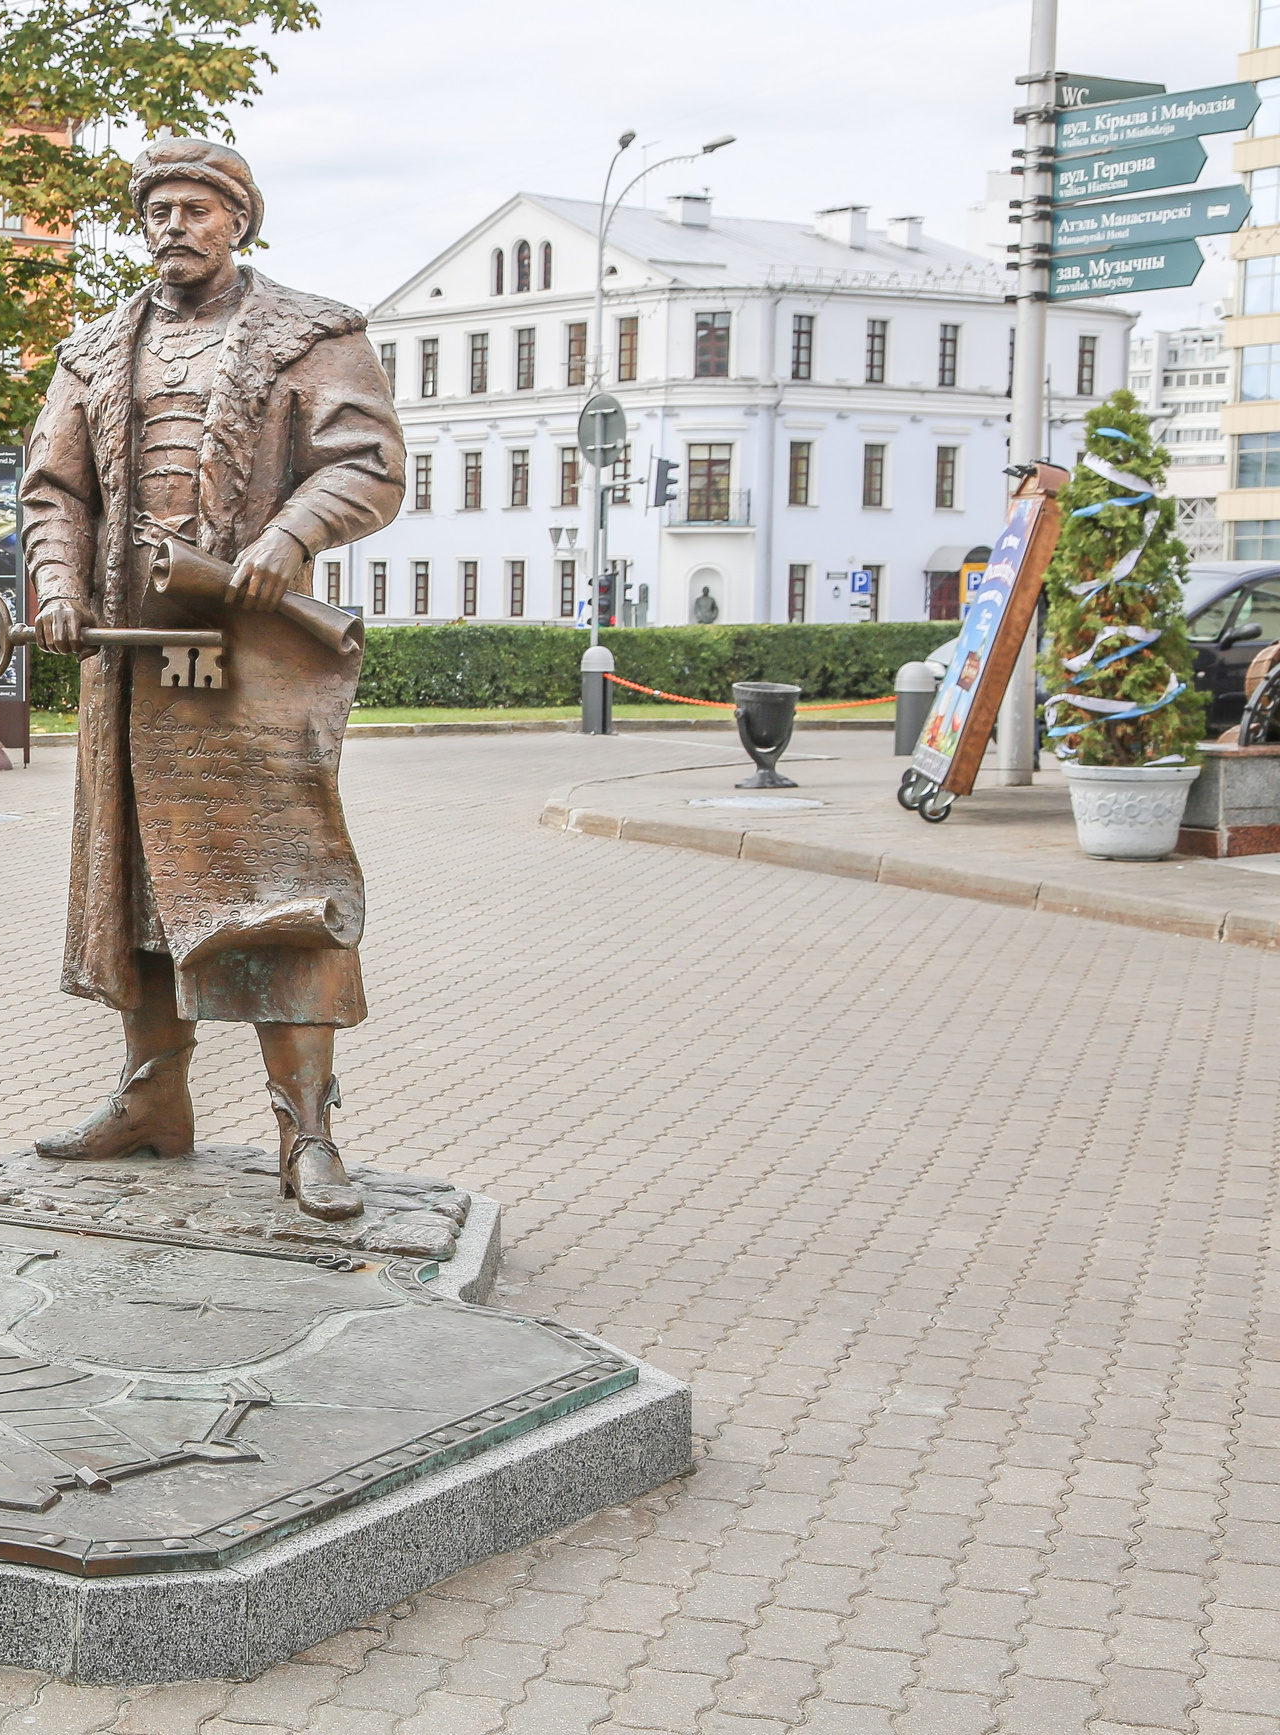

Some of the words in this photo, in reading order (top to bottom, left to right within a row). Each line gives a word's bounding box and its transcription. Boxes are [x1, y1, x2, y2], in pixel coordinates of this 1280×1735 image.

[1061, 86, 1089, 106] WC
[1063, 121, 1090, 139] вул.
[1095, 111, 1148, 132] Кірыла
[1160, 95, 1236, 121] Мяфодзія
[1059, 170, 1088, 188] вул.
[1093, 156, 1156, 180] Герцэна
[1058, 217, 1098, 234] Атэль
[1101, 203, 1191, 228] Манастырскі
[1055, 264, 1084, 281] зав.
[1088, 254, 1165, 279] Музычны
[854, 574, 867, 591] P
